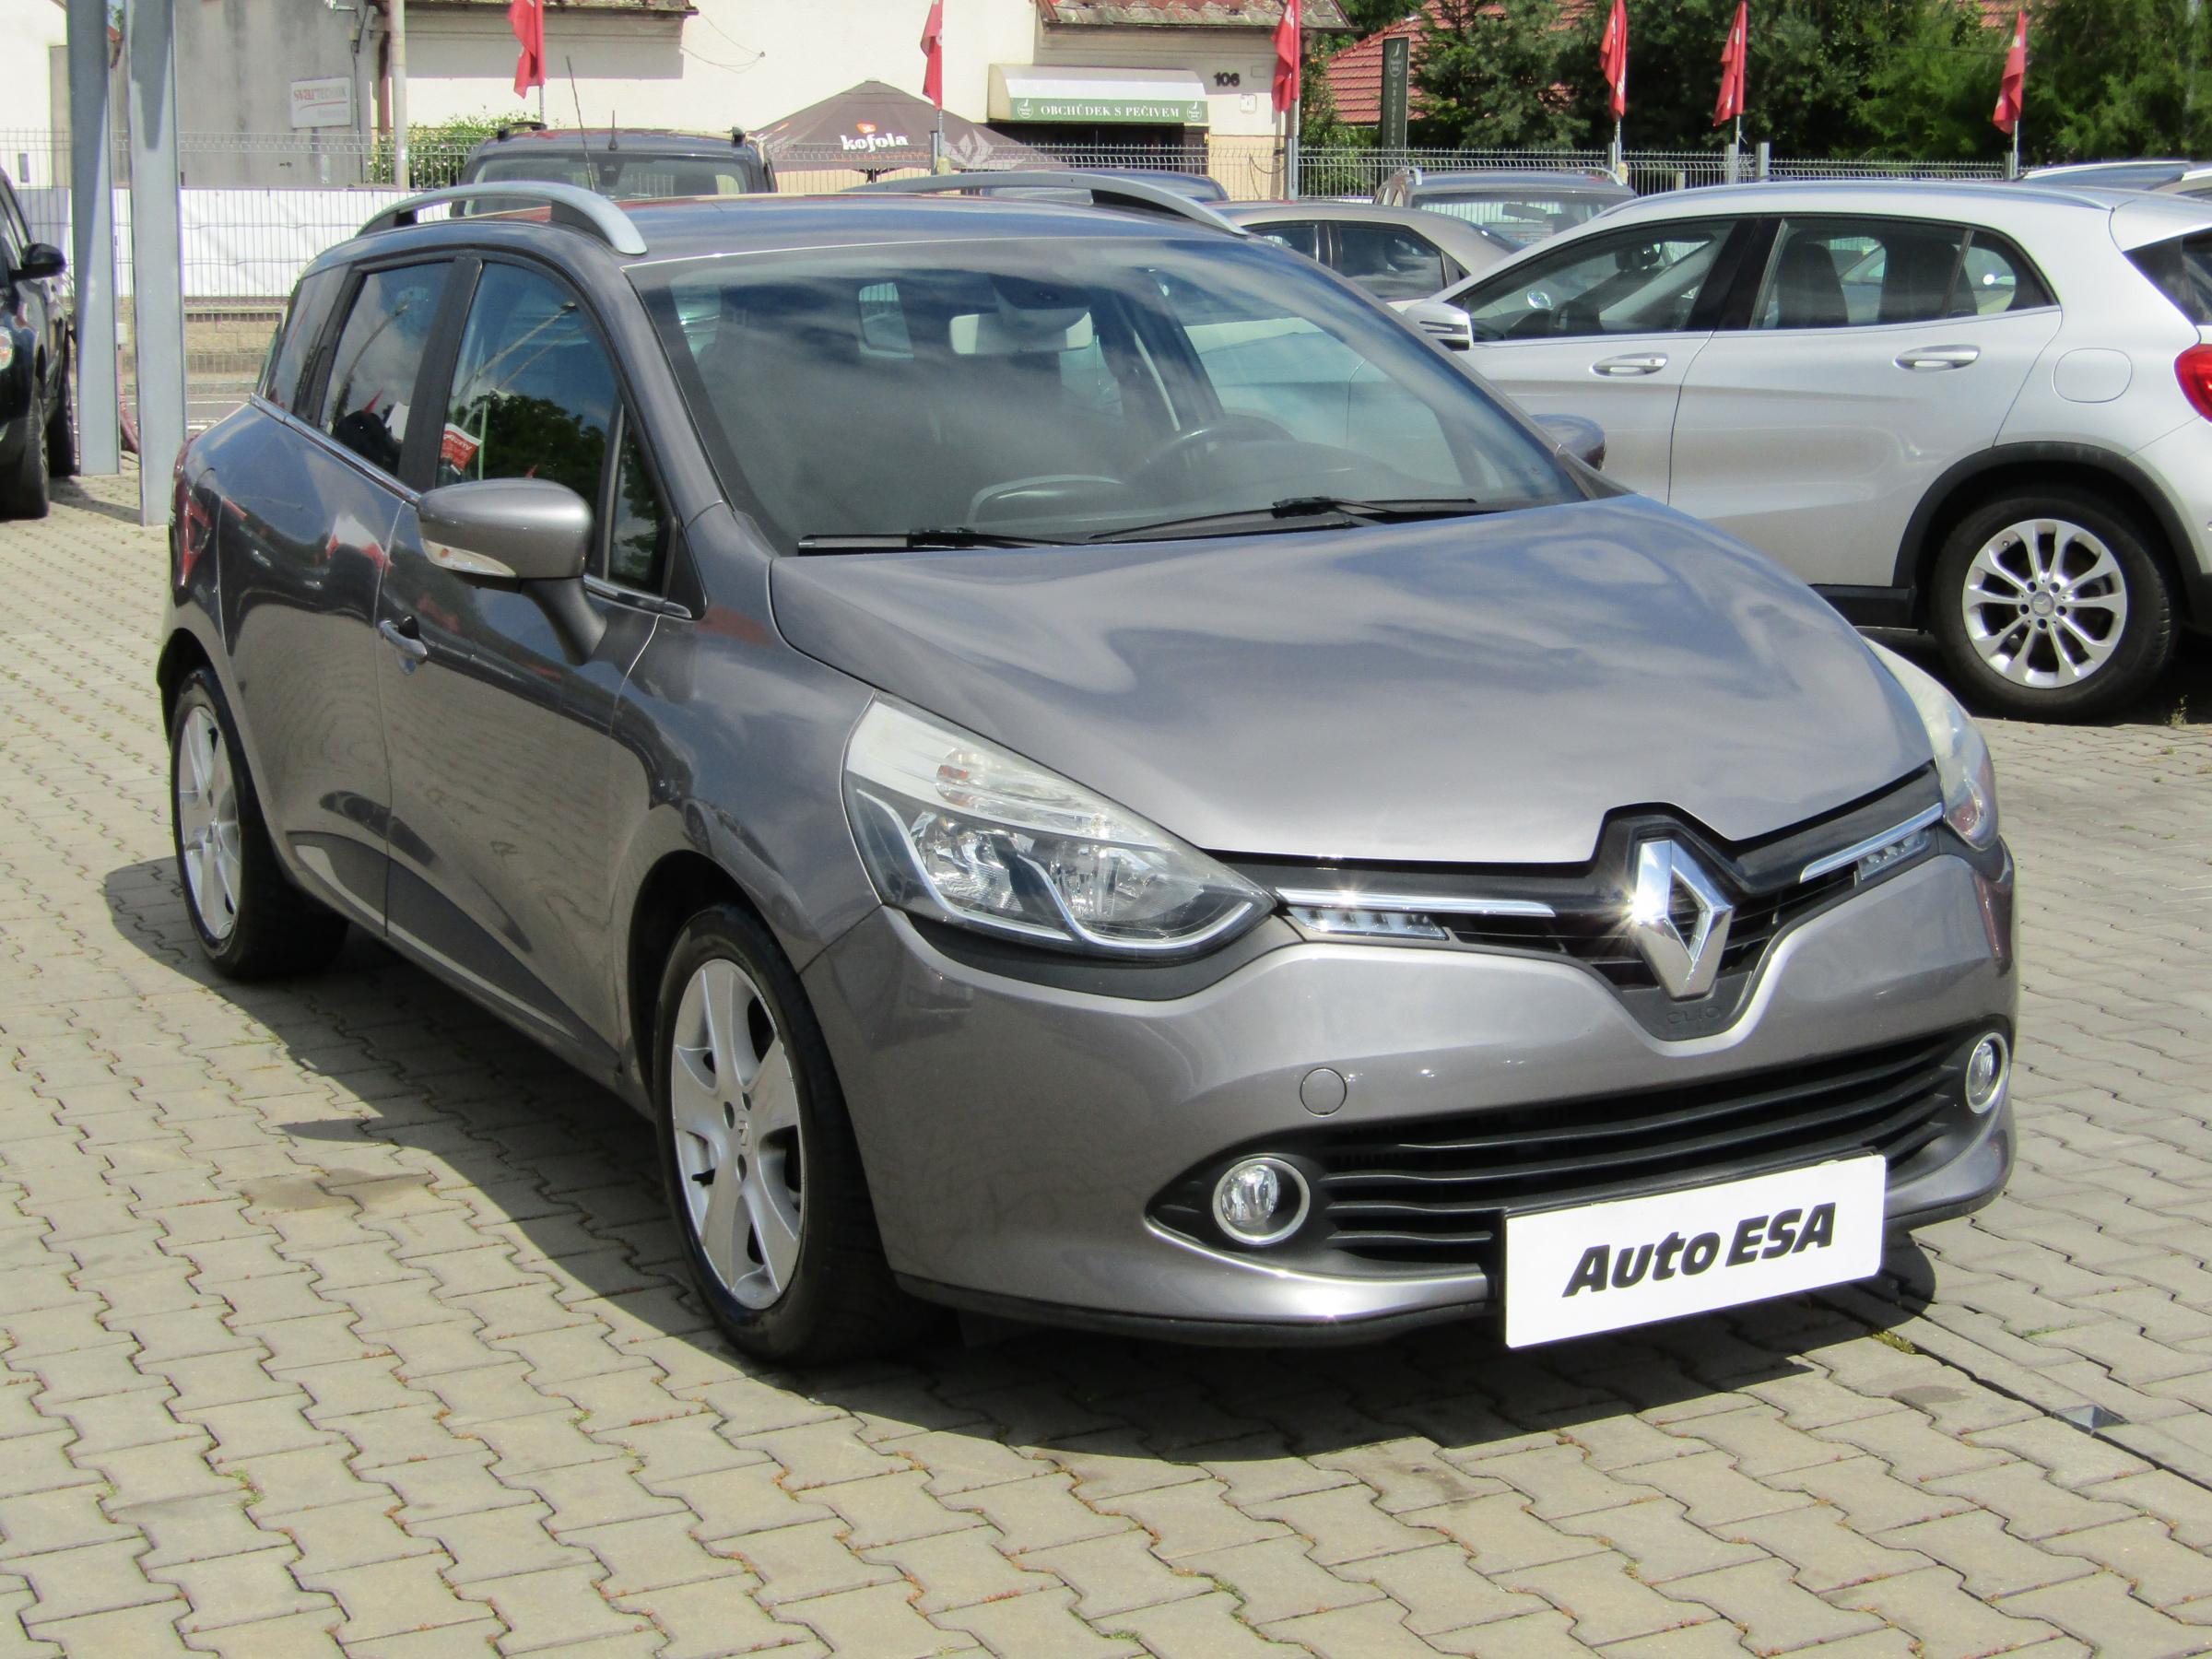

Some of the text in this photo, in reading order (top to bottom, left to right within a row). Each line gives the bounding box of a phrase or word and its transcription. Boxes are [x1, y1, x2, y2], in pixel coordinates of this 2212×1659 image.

[1213, 72, 1240, 88] 106
[1041, 103, 1112, 116] OBCHŮDEK
[1114, 106, 1122, 116] S
[1125, 105, 1179, 118] PEČIVEM
[840, 133, 908, 152] kofola
[1666, 1006, 1722, 1024] CLIO
[1561, 1202, 1836, 1298] Auto ESA
